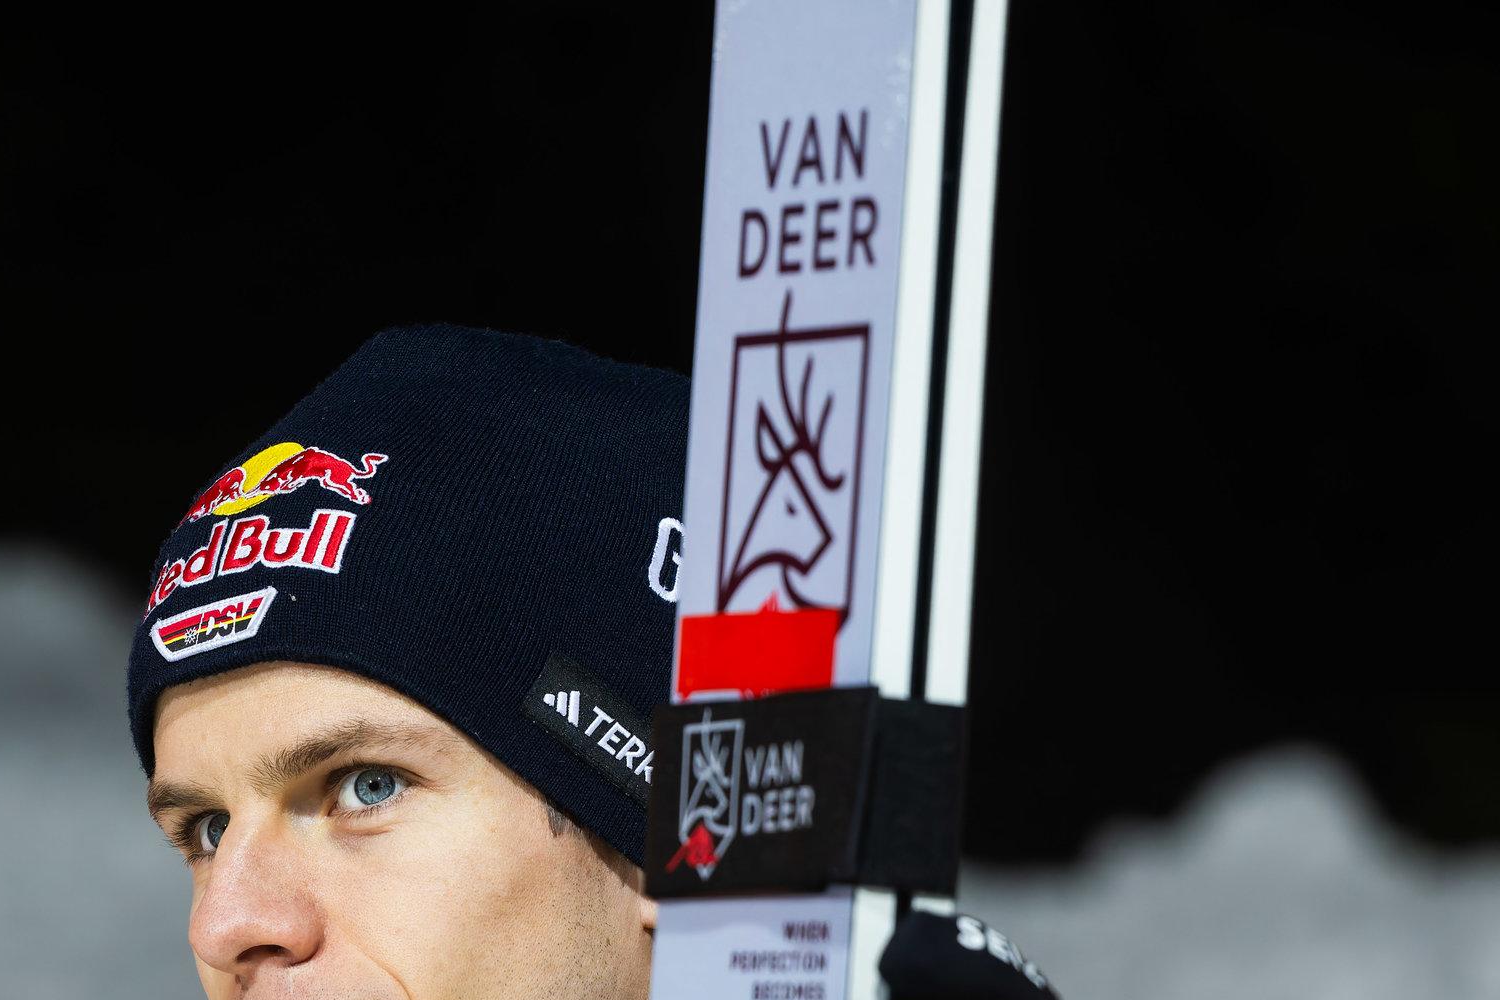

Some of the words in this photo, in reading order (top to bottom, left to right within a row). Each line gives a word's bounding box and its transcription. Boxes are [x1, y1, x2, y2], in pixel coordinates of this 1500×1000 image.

[759, 108, 870, 192] VAN
[737, 196, 880, 279] DEER
[218, 508, 357, 575] Bull
[200, 597, 266, 642] DSV
[743, 739, 805, 790] VAN
[740, 785, 816, 837] DEER
[729, 950, 827, 973] PERFECTION
